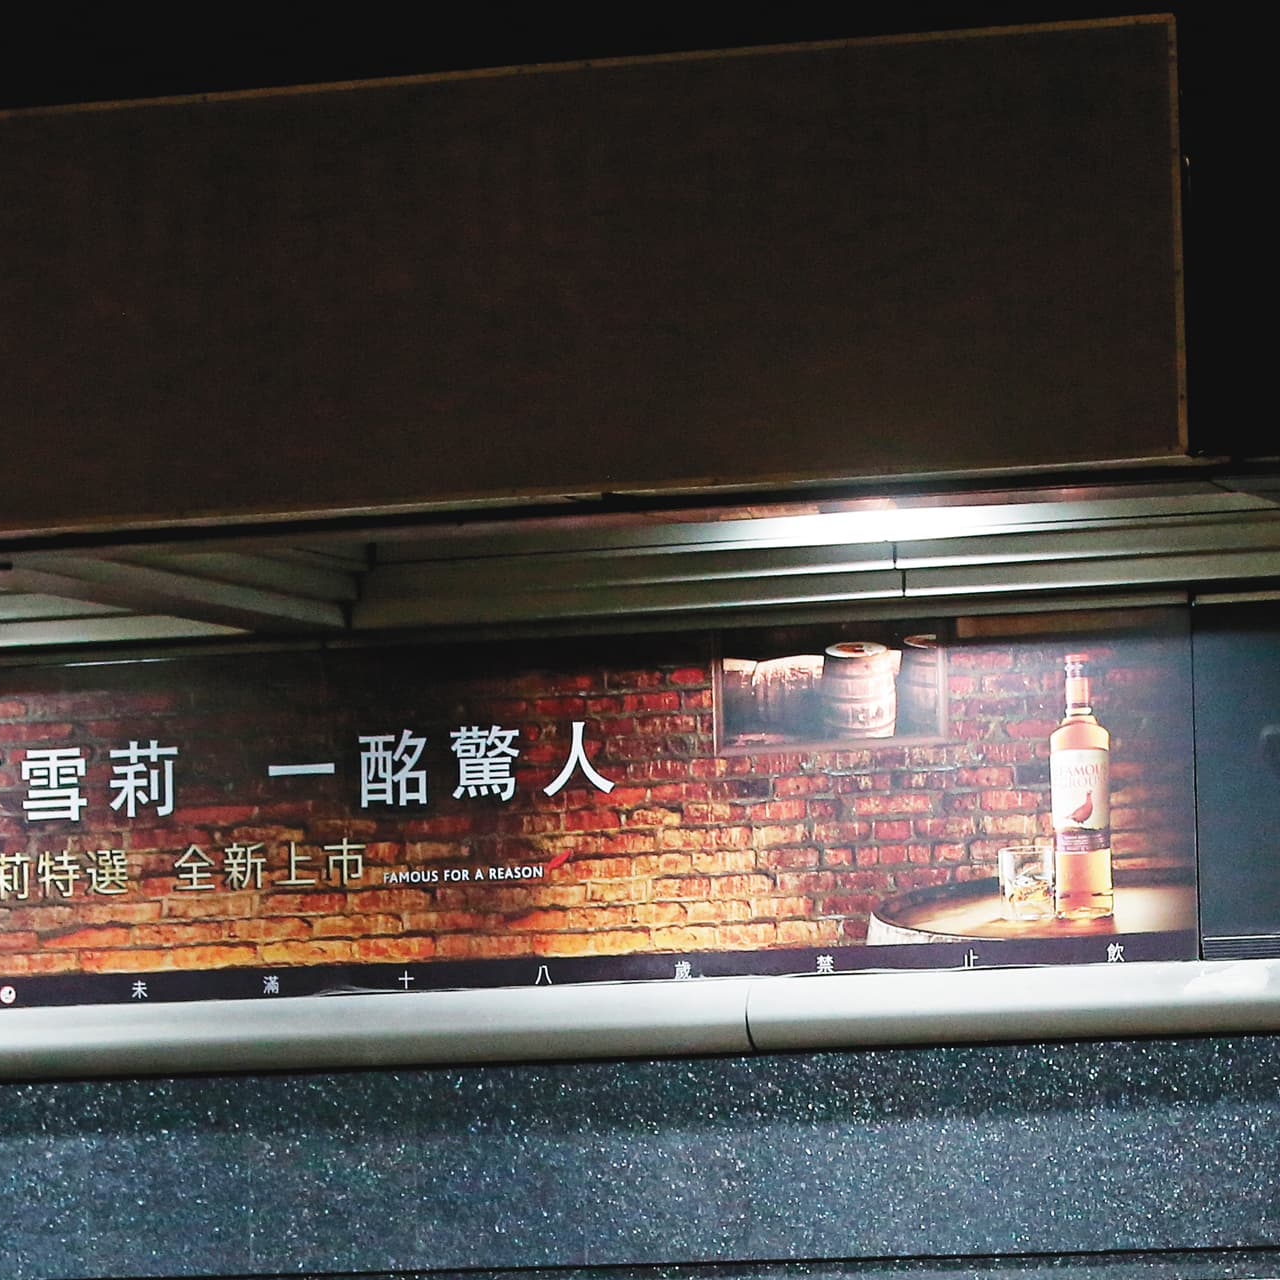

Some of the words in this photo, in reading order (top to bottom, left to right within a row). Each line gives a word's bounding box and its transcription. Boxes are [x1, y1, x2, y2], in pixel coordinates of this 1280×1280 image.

[268, 721, 616, 809] 一酩驚人
[174, 837, 367, 892] 全新上市
[383, 870, 439, 884] FAMOUS
[443, 869, 470, 881] FOR
[474, 868, 484, 880] A
[489, 866, 544, 880] REASON
